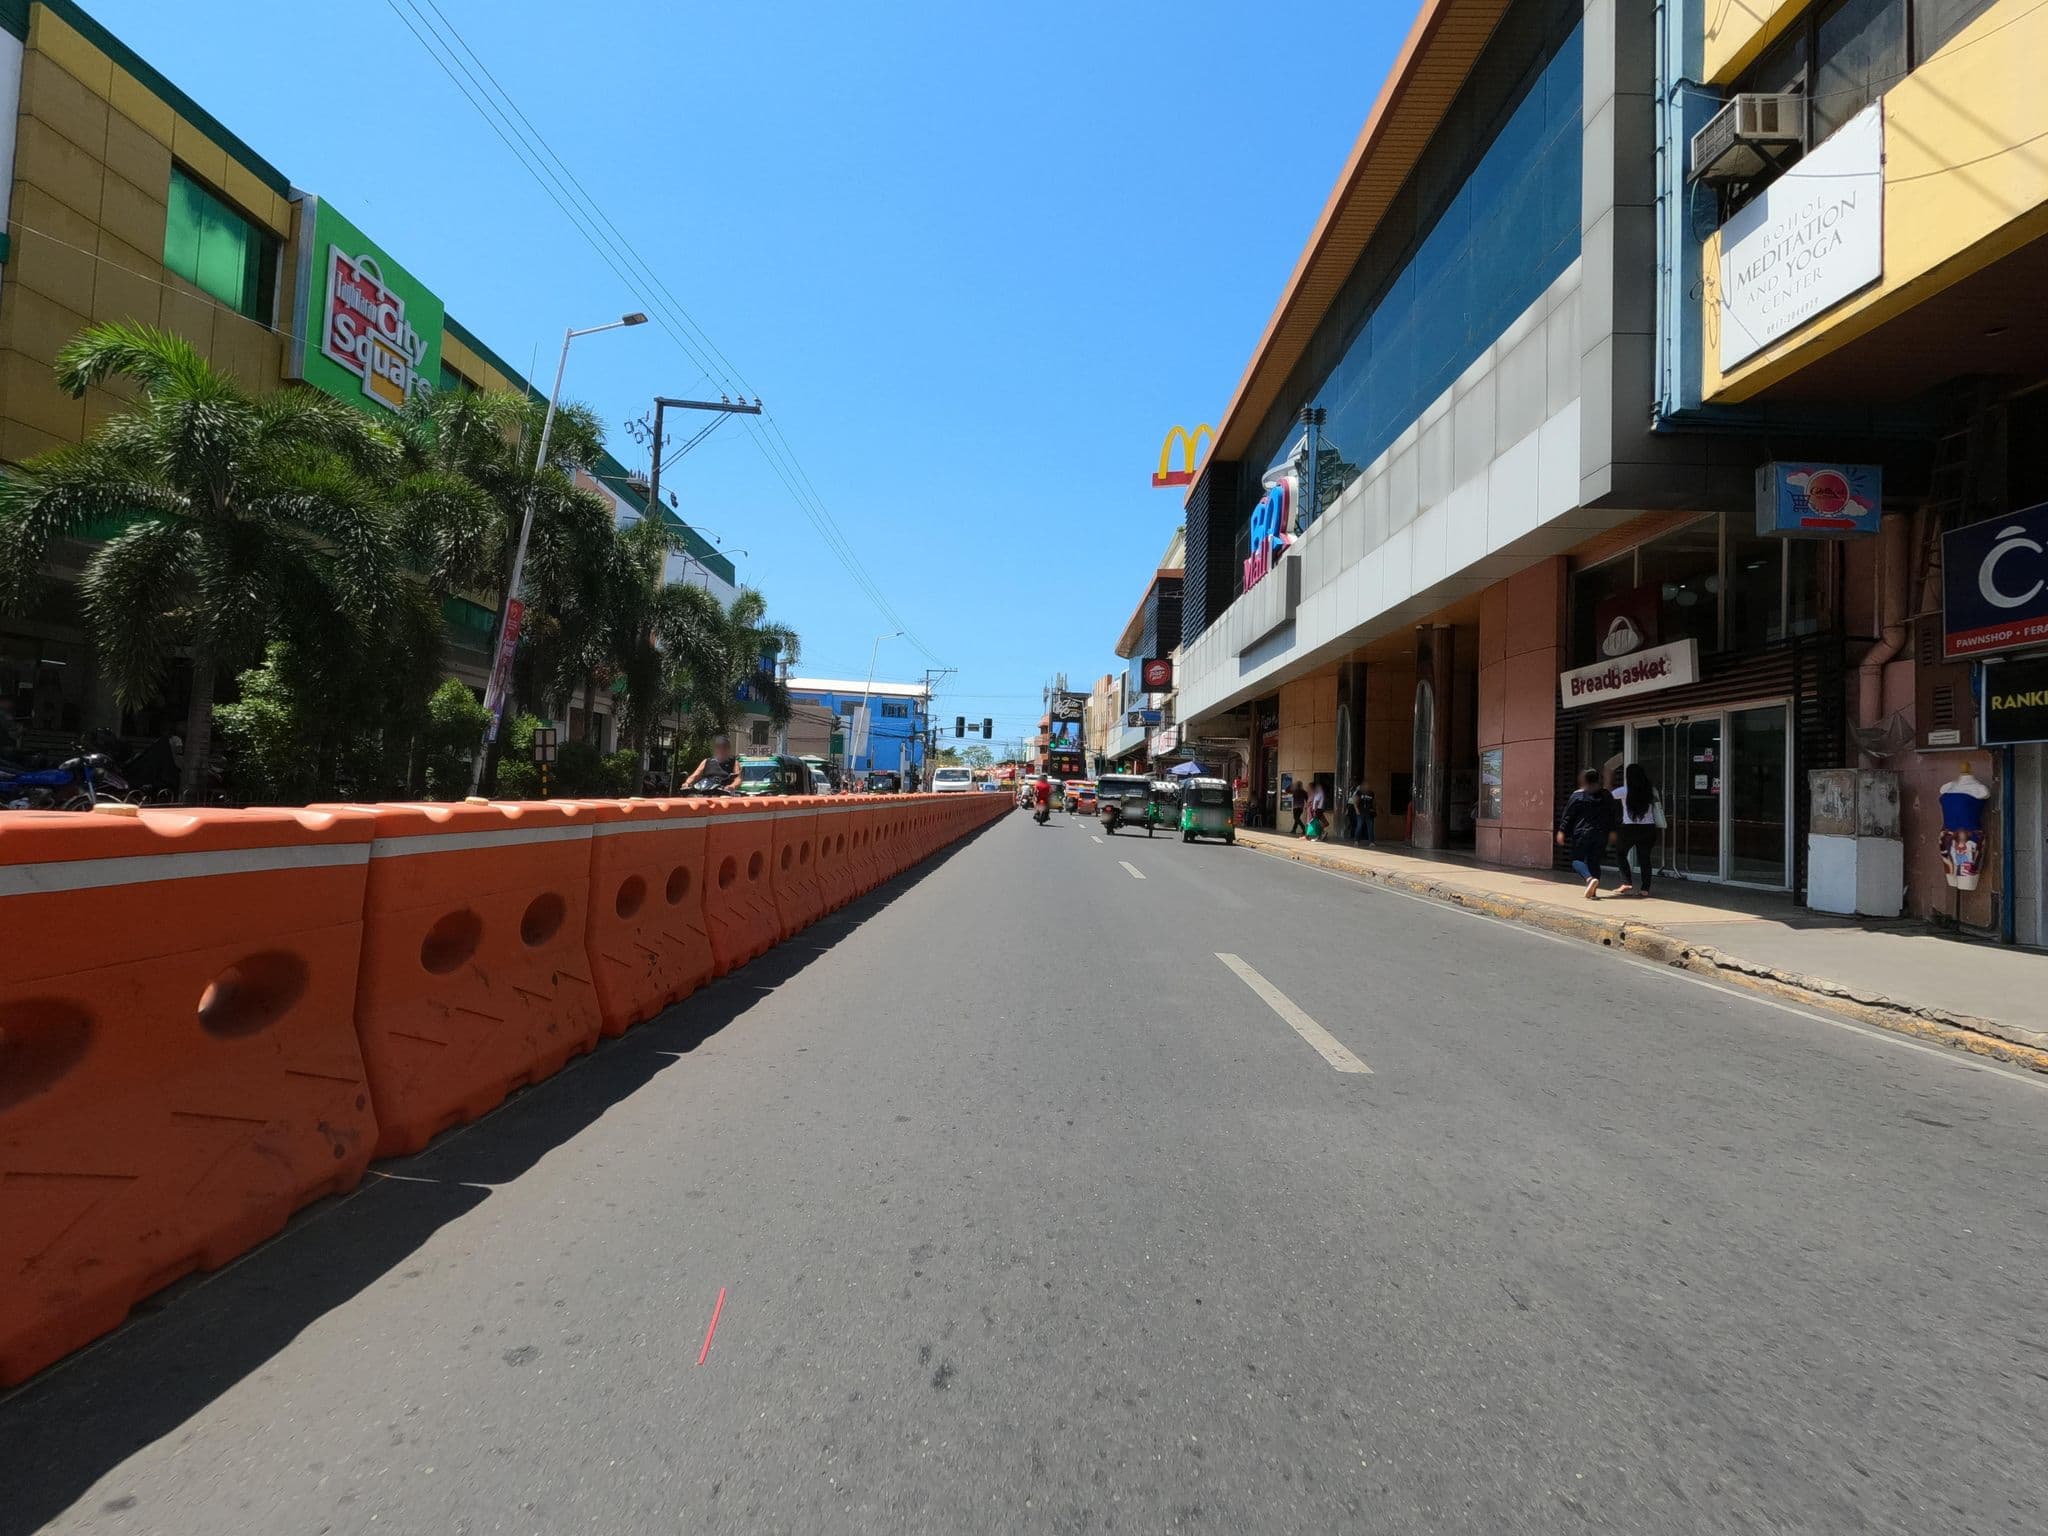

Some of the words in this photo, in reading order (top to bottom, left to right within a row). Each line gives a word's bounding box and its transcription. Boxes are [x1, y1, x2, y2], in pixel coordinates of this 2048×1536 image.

[1736, 191, 1857, 290] MEDITATION
[1763, 194, 1825, 248] BOHOL
[1746, 273, 1779, 304] AND
[1785, 229, 1843, 279] YOGA
[1761, 266, 1824, 315] CENTER
[333, 314, 433, 401] Square
[376, 303, 428, 367] City
[1243, 538, 1270, 594] Mall
[1956, 630, 2013, 648] PAWNSHOP
[1571, 656, 1667, 697] Breadbasket
